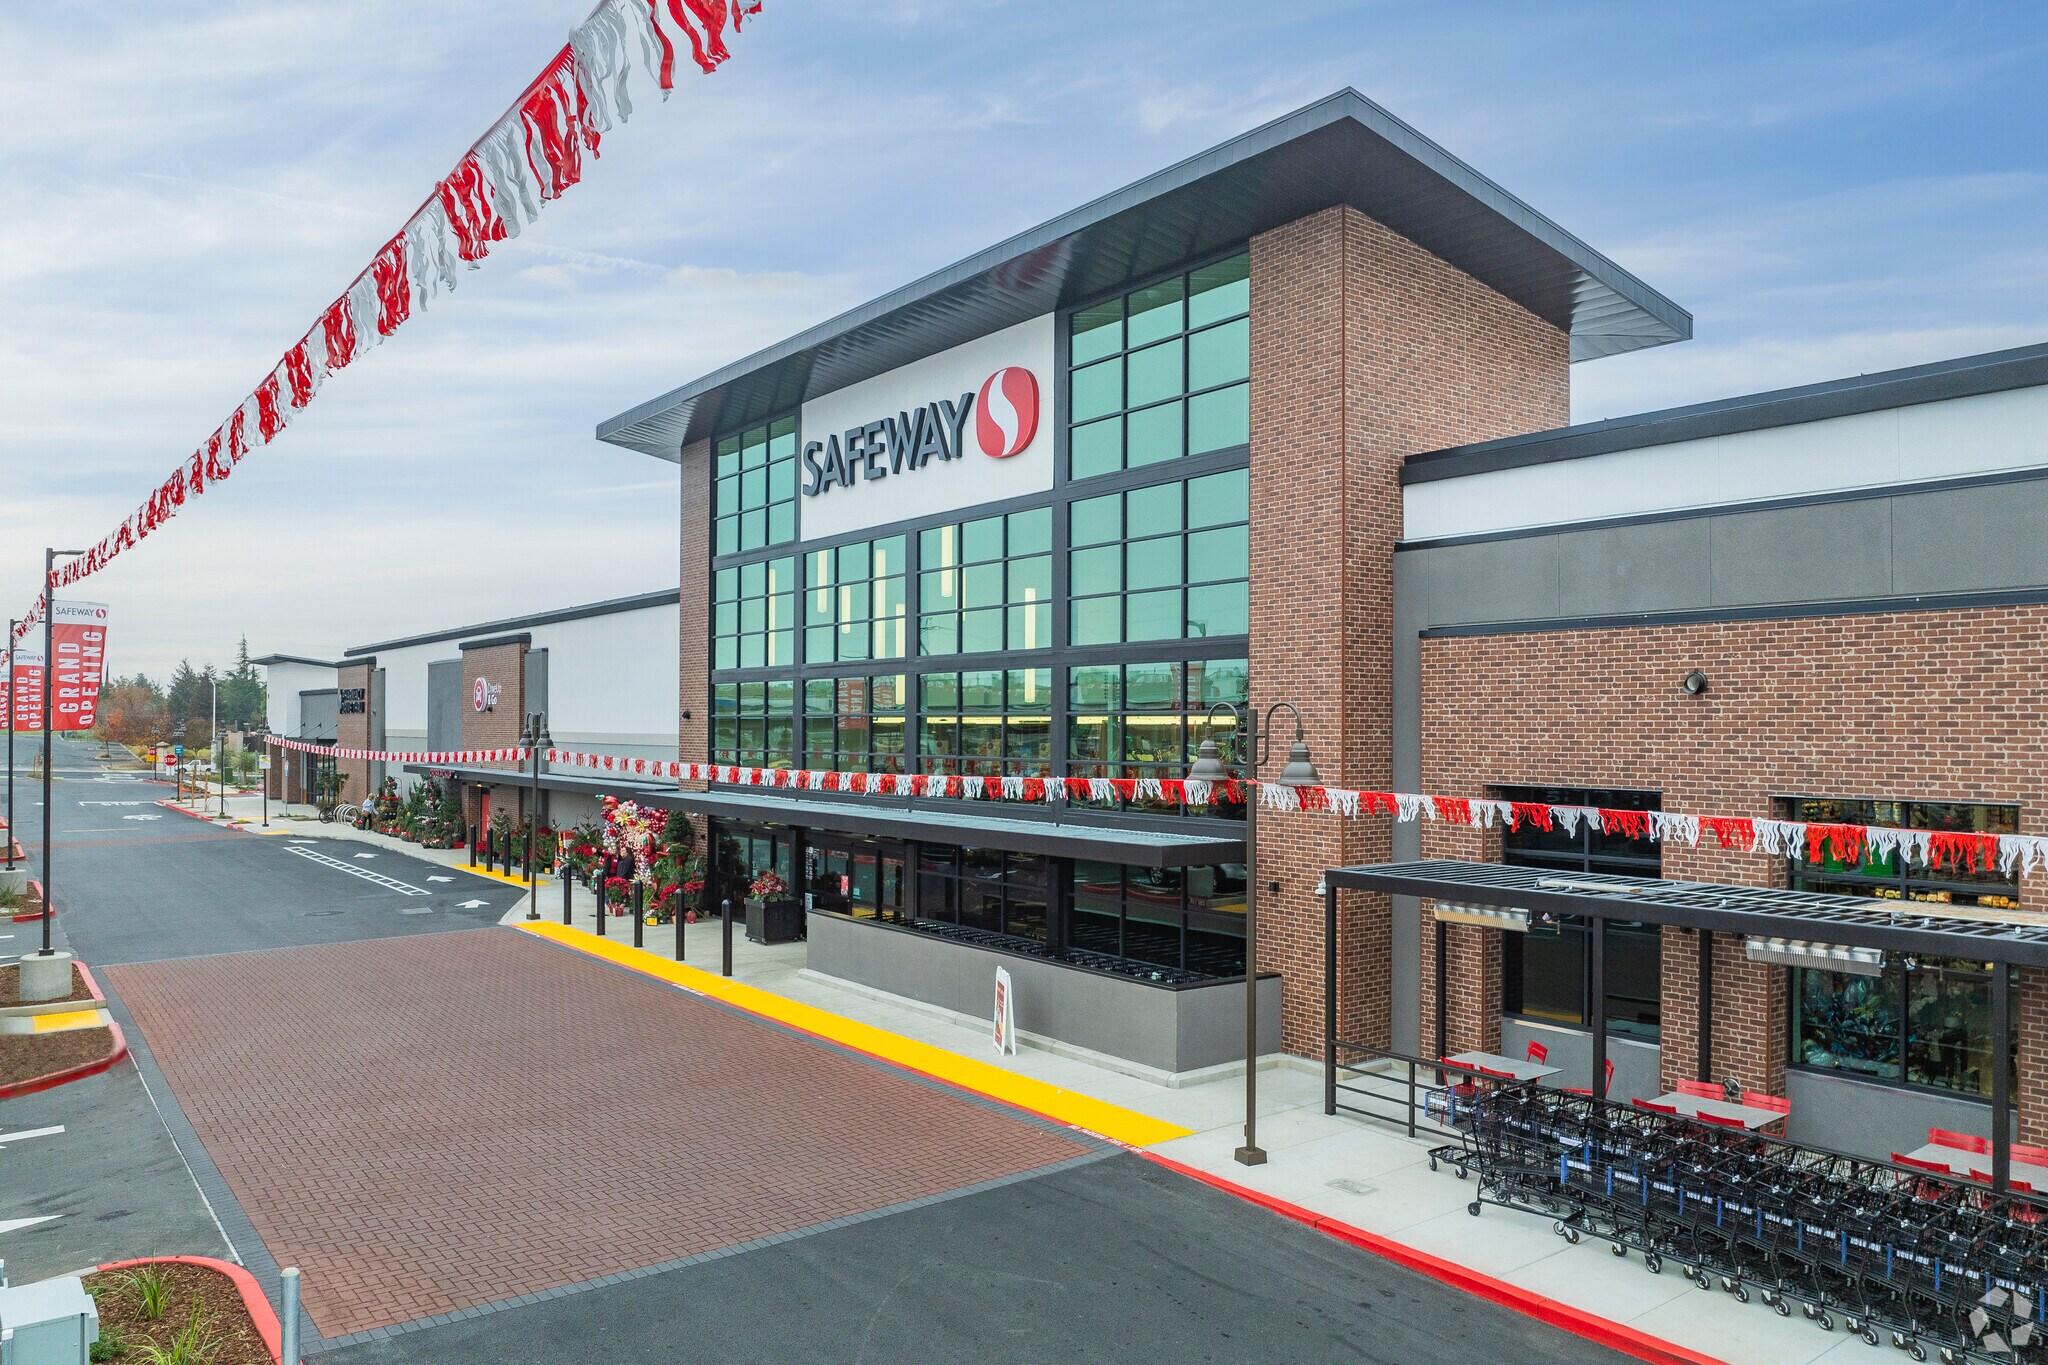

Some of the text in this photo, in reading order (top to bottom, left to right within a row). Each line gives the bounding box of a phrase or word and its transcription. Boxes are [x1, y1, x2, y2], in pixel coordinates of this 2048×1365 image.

[803, 392, 975, 496] SAFEWAY
[55, 606, 95, 617] SAFEWAY
[16, 676, 29, 721] GRAND
[29, 669, 42, 728] OPENING
[58, 642, 80, 713] GRAND
[79, 631, 103, 725] OPENING
